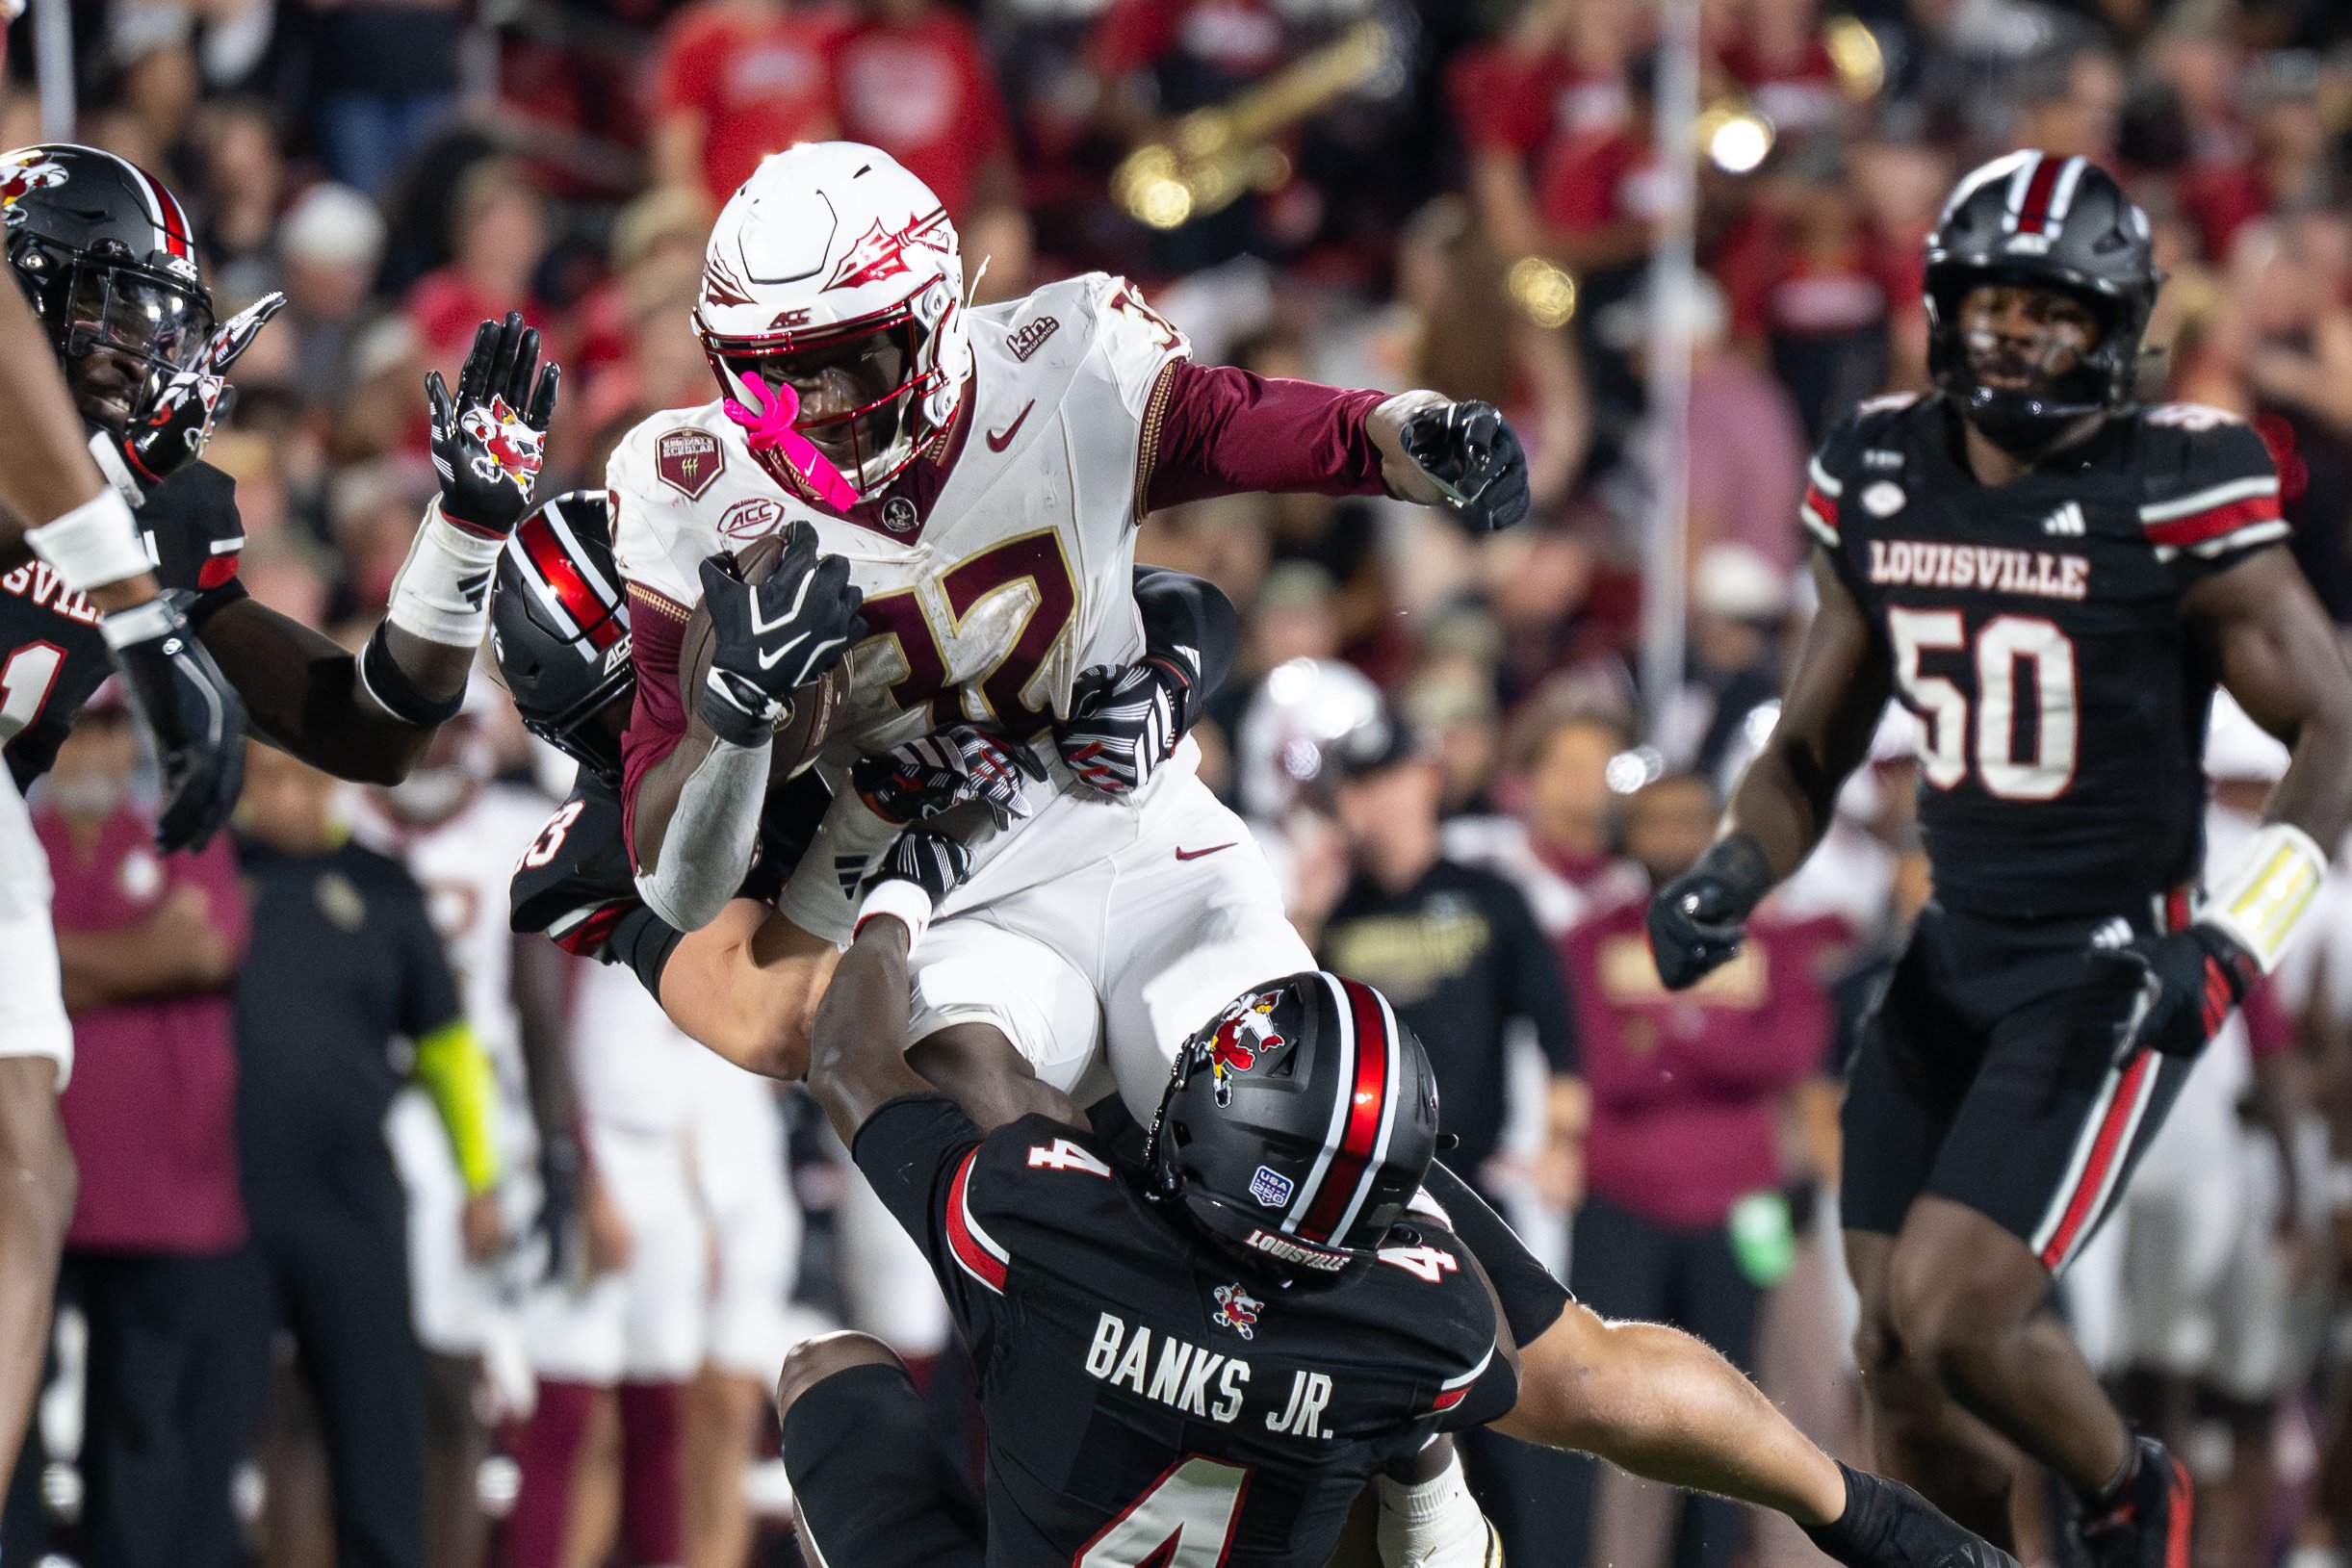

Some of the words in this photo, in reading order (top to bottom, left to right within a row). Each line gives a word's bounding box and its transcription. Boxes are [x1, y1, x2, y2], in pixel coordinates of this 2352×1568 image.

[766, 307, 812, 330] ACC
[1007, 319, 1053, 355] kin.
[725, 500, 772, 533] ACC
[1869, 539, 2091, 600] LOUISVILLE
[1887, 604, 2081, 803] 50
[1026, 1138, 1113, 1180] 4
[1252, 1182, 1285, 1204] 250
[1259, 1170, 1288, 1192] USA
[1245, 1228, 1352, 1272] LOUISVILLE
[1377, 1245, 1460, 1284] 4
[1085, 1311, 1251, 1424] BANKS
[1265, 1370, 1333, 1439] JR.
